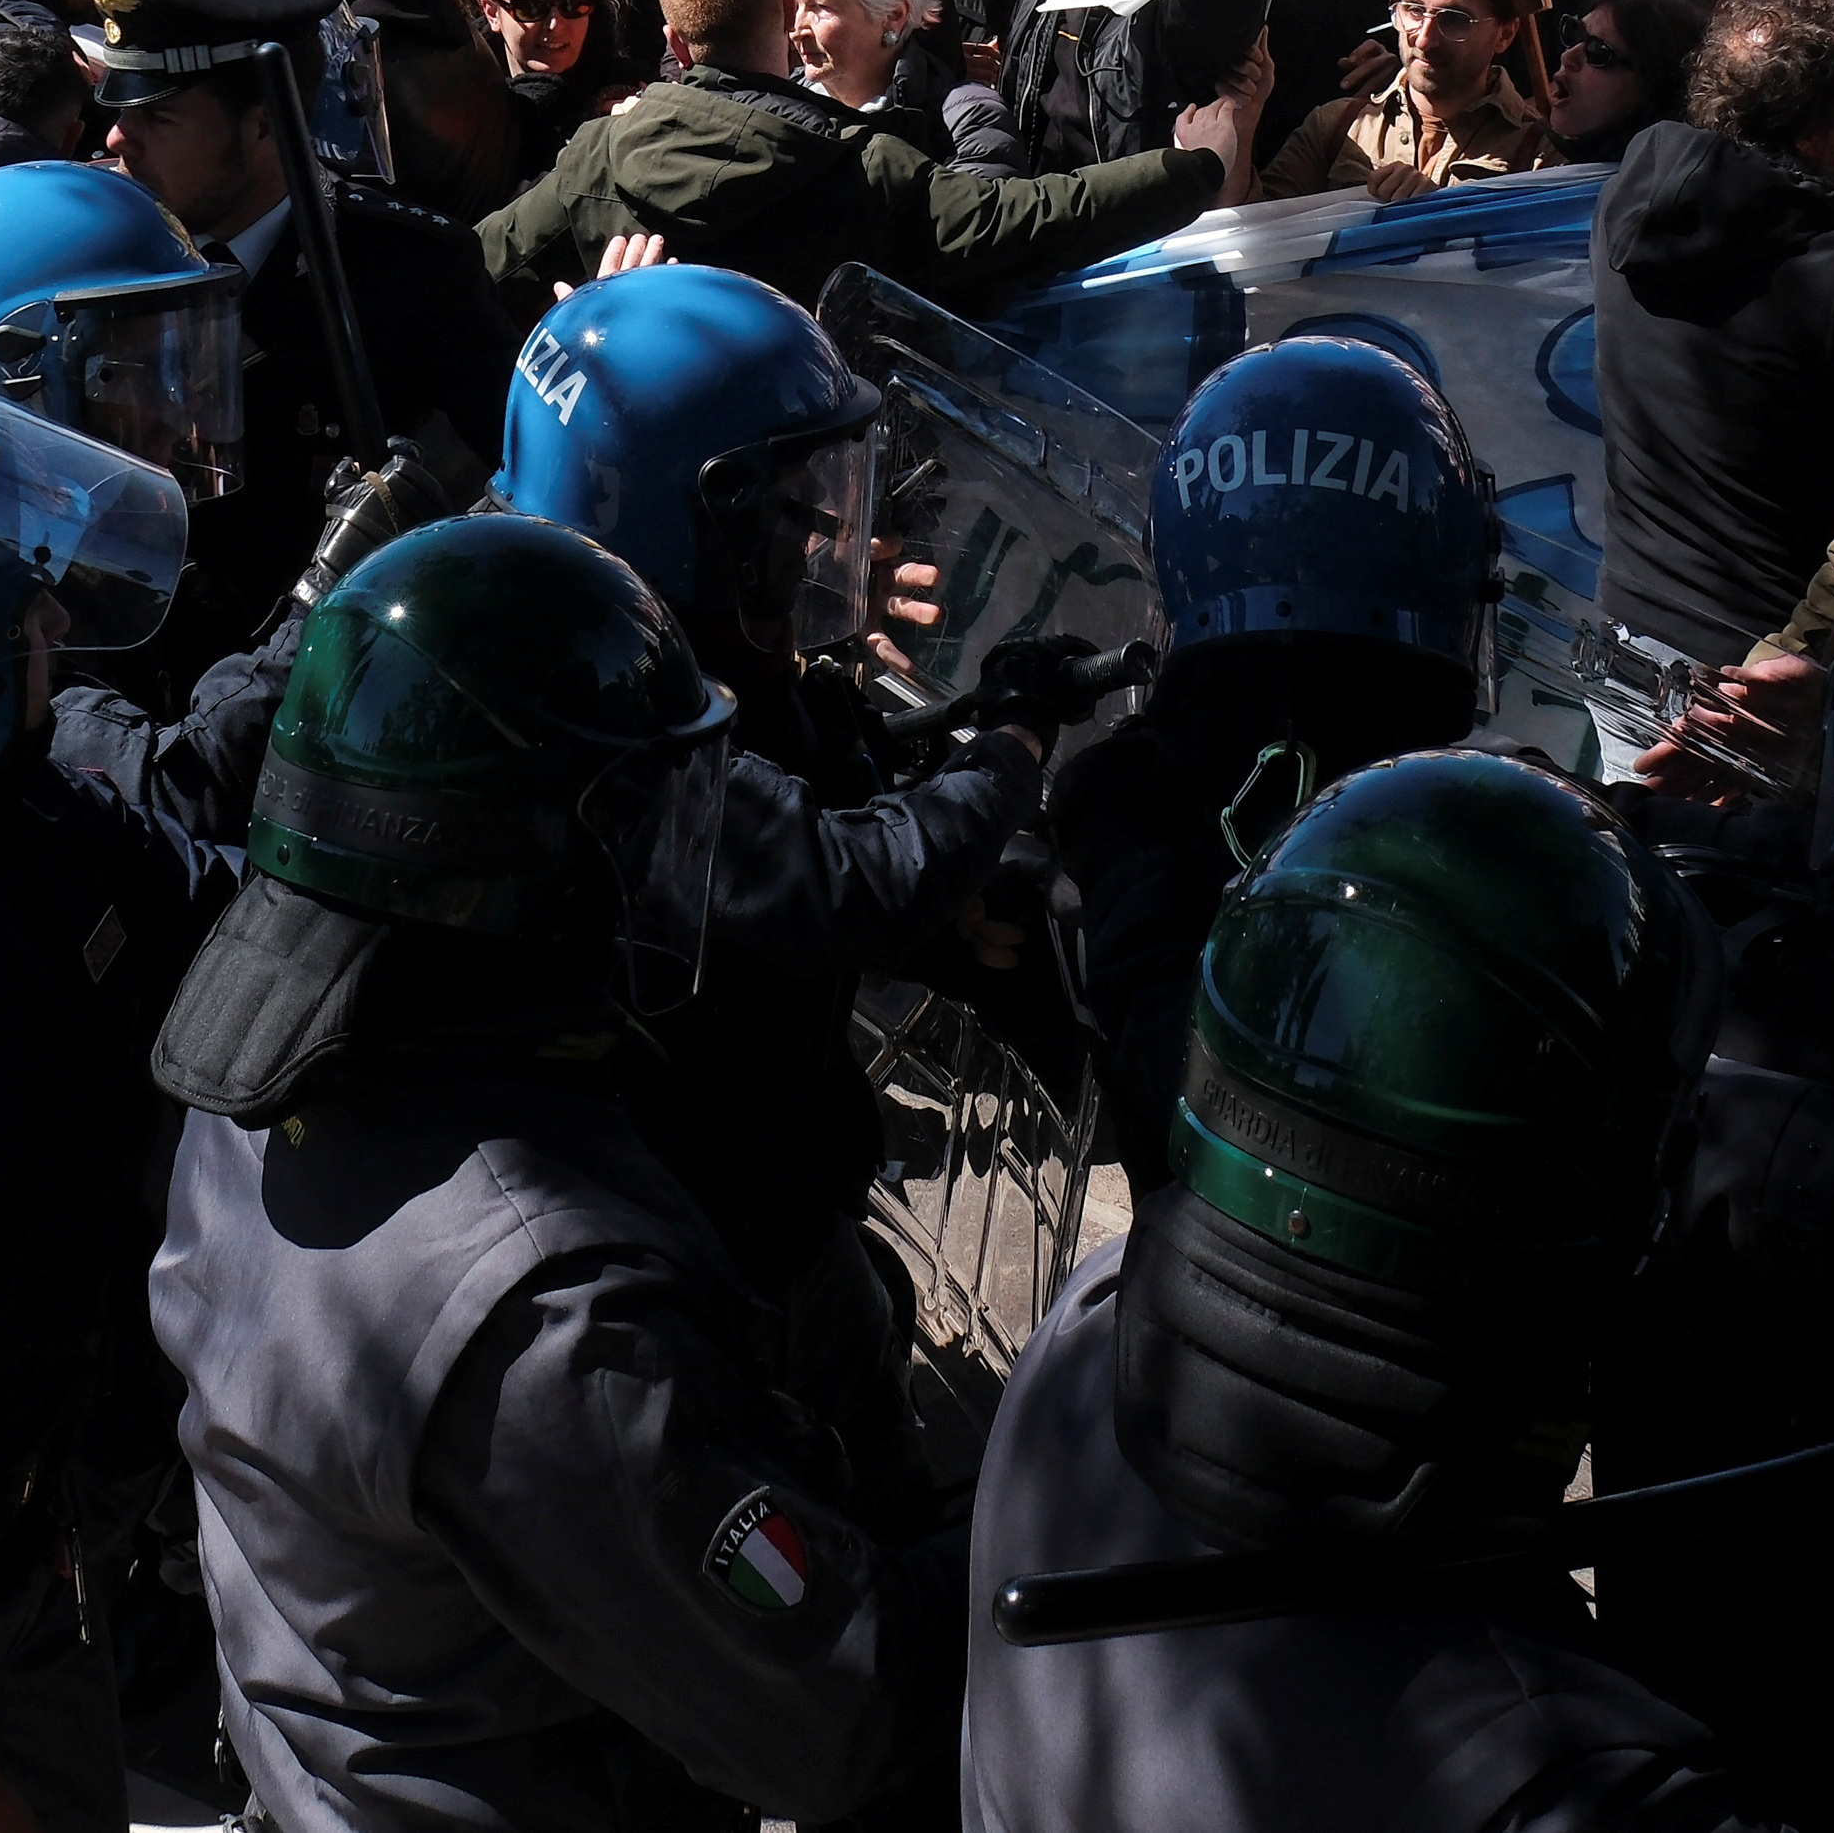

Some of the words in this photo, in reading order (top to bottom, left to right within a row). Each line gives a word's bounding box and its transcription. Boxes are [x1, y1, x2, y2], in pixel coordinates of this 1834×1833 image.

[1175, 428, 1409, 514] POLIZIA
[1202, 1078, 1297, 1161] GUARDIA
[715, 1501, 771, 1566] ITALIA
